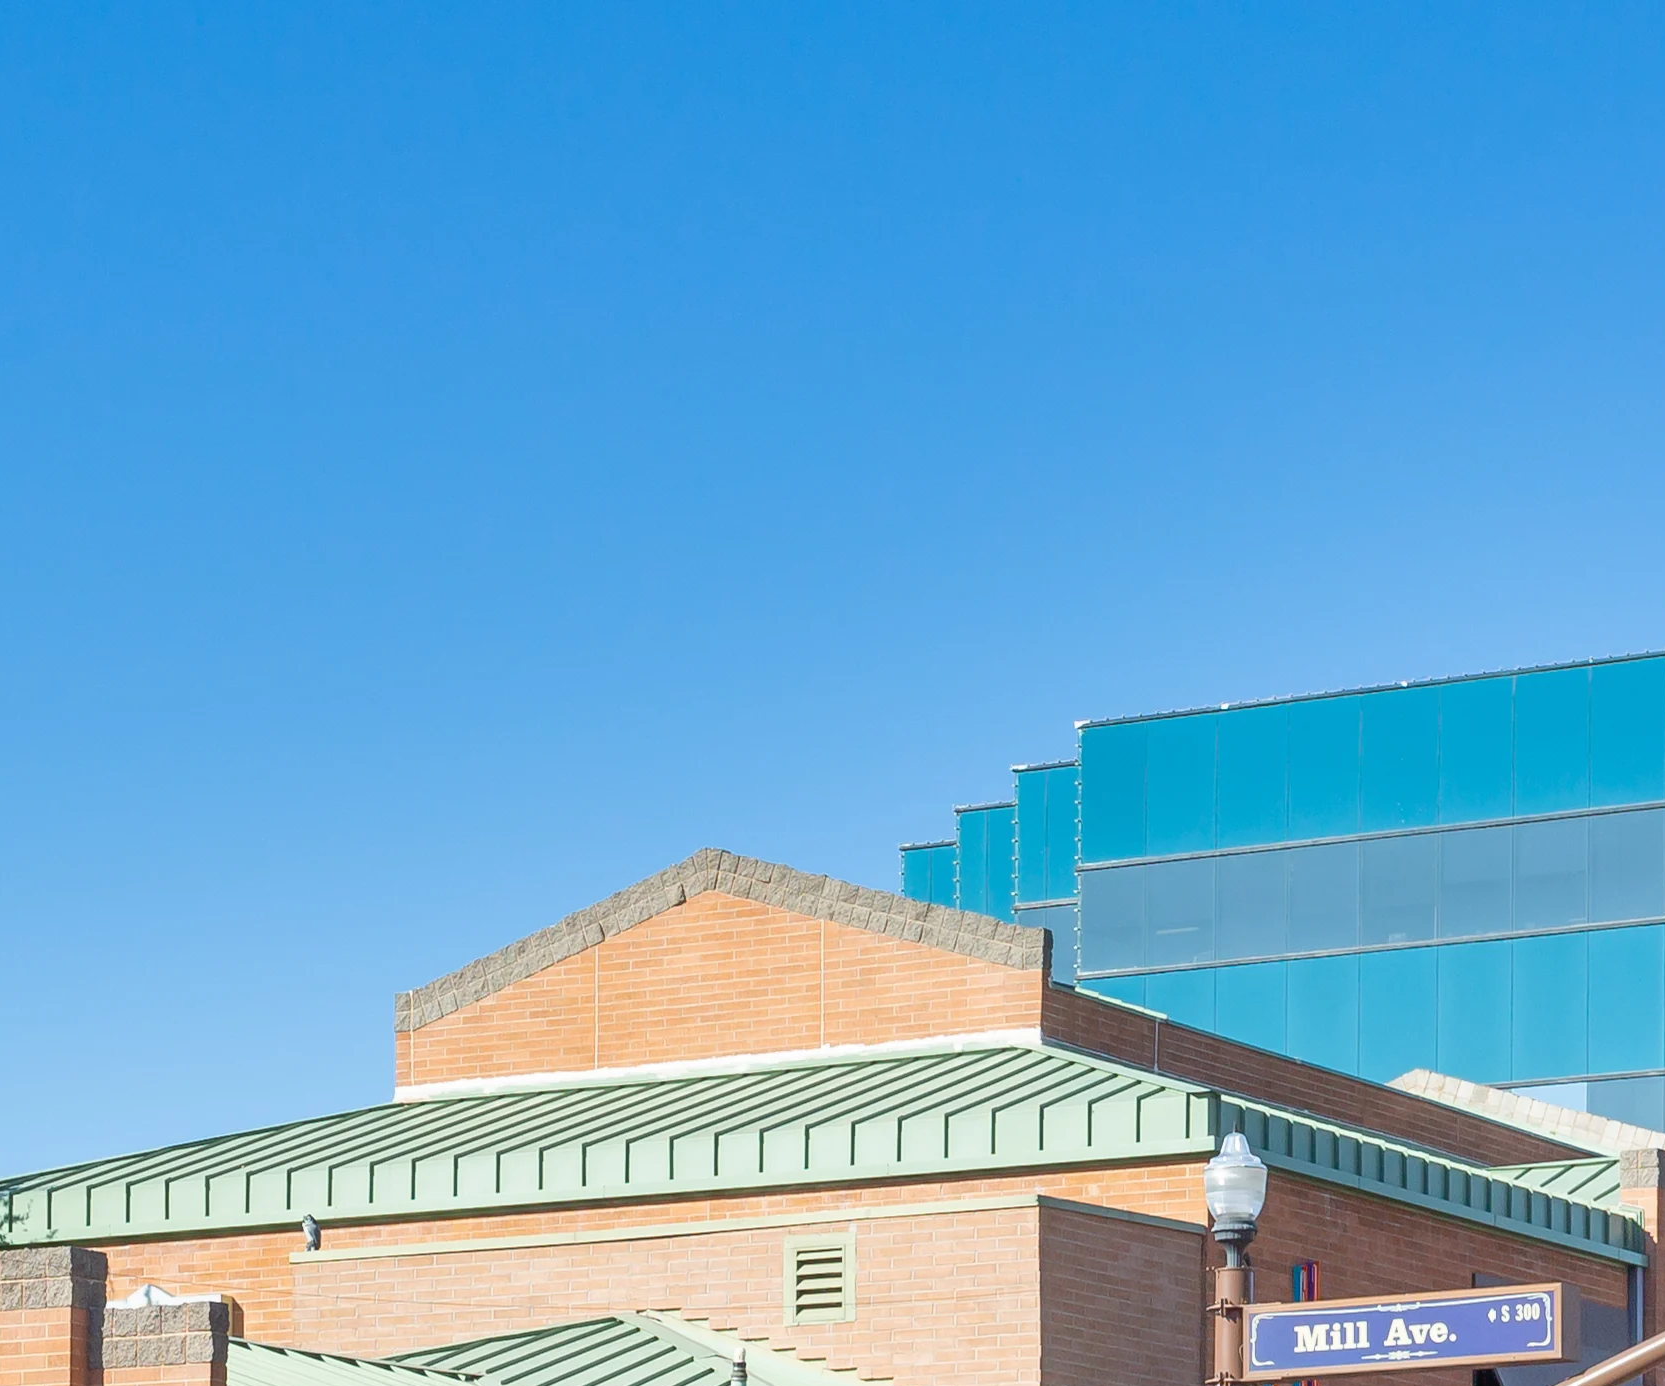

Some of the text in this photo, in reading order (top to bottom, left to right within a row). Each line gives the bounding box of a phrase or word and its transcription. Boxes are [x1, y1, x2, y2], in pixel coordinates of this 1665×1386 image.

[1500, 1303, 1541, 1323] S 300
[1293, 1317, 1458, 1354] Mill Ave.
